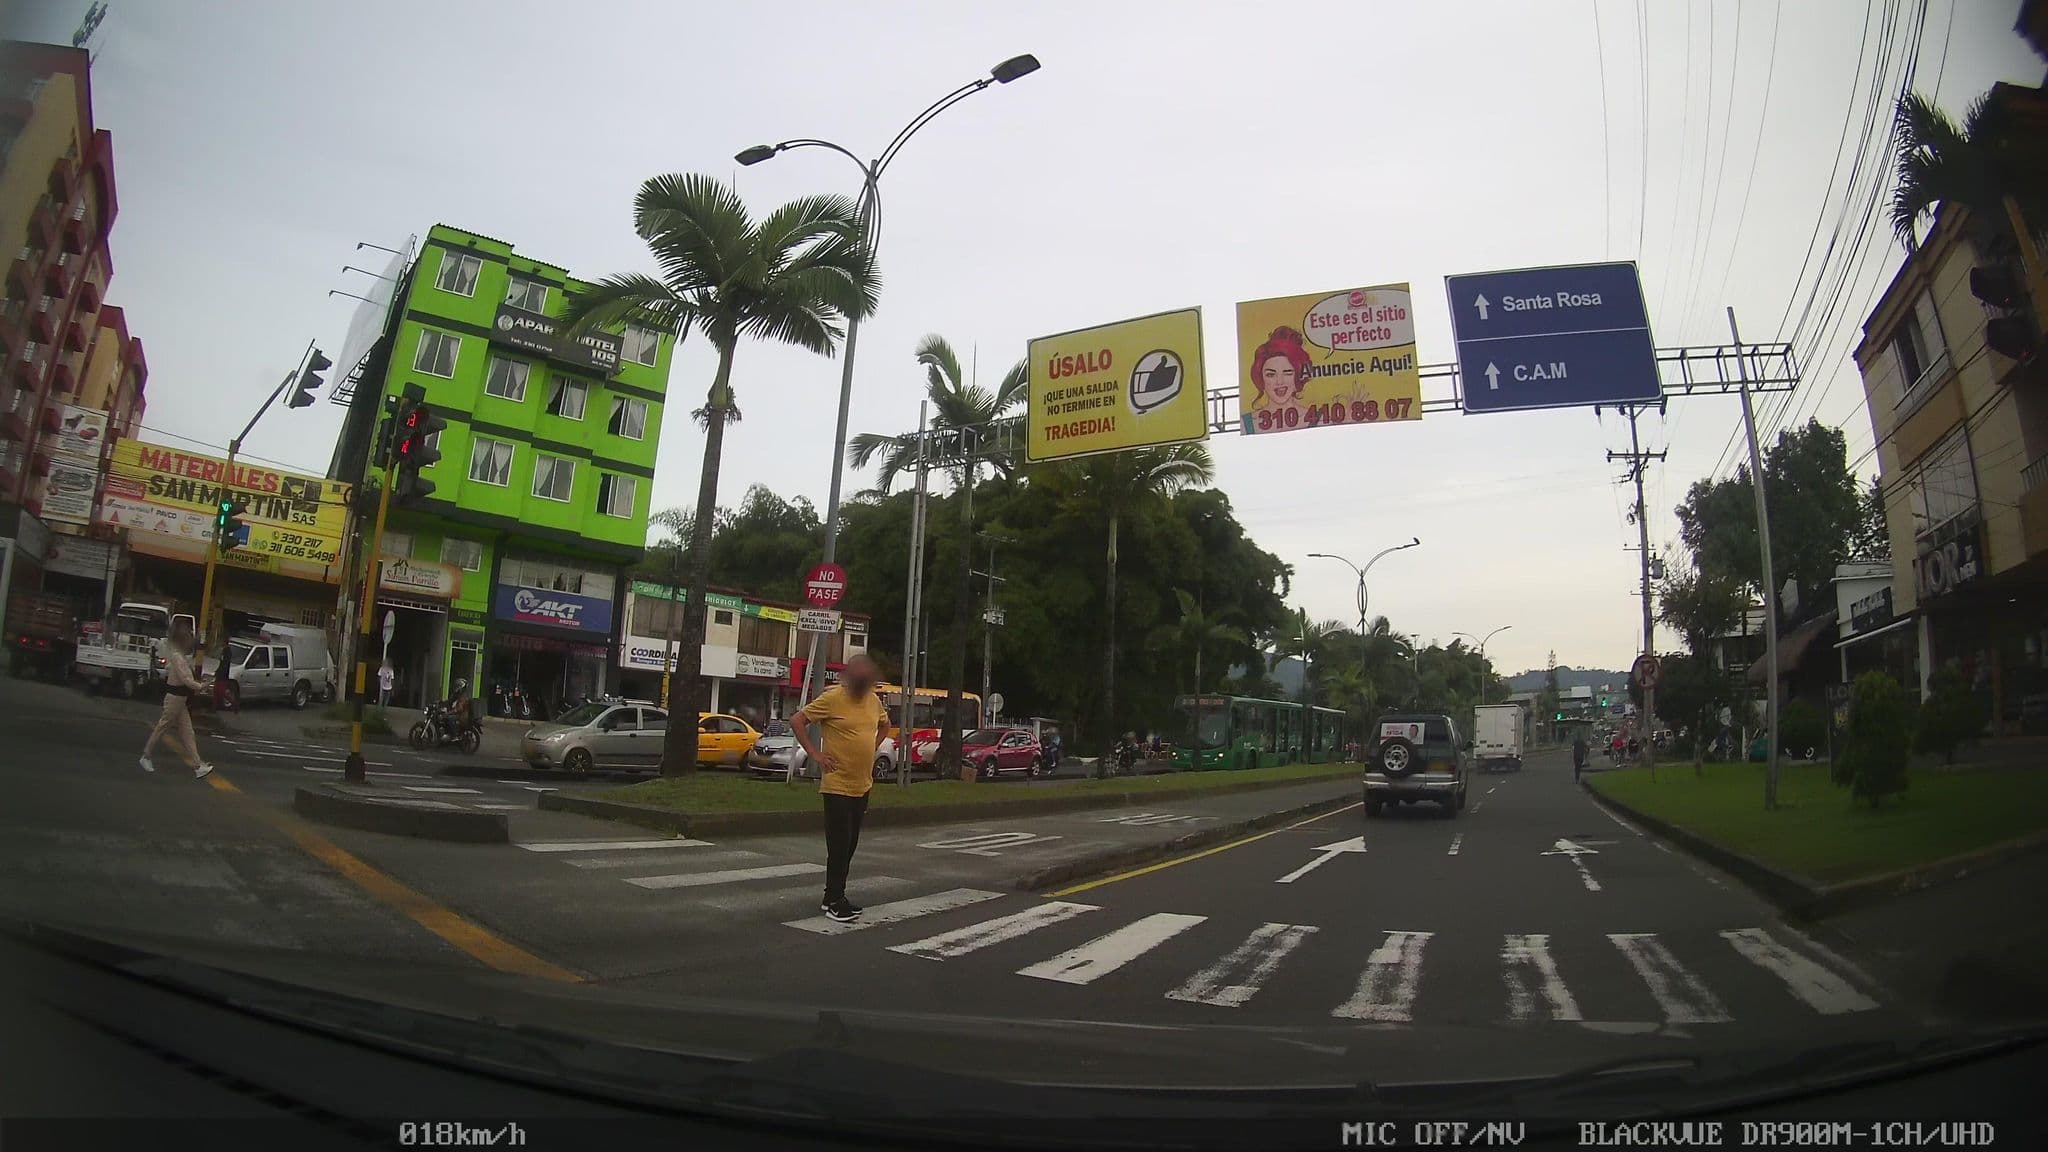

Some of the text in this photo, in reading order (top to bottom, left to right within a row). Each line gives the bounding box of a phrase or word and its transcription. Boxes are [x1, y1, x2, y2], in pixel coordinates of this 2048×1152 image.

[1502, 291, 1603, 312] Santa Rosa
[1310, 304, 1406, 329] Este es el sitio
[1331, 326, 1392, 350] perfecto
[591, 348, 616, 364] 109
[1048, 348, 1112, 379] ÚSALO
[1300, 358, 1365, 379] Anuncie
[1513, 361, 1568, 382] C.A.M
[1066, 385, 1085, 398] UNA
[1086, 380, 1119, 395] SALIDA
[1047, 395, 1116, 416] NO TERMINE EN
[1258, 397, 1413, 430] 310 410 88 07
[1045, 415, 1116, 441] TRAGEDIA!
[140, 446, 279, 492] MATERIALES
[148, 474, 196, 503] SAN
[199, 484, 291, 521] MARTIN
[280, 532, 323, 549] 330 2117
[269, 542, 336, 563] 311 606 5498
[819, 570, 835, 582] NO
[808, 588, 840, 600] PASE
[530, 600, 583, 620] AKT
[800, 617, 836, 625] EXCLSIVO
[801, 623, 832, 631] MEGABUS
[631, 647, 677, 660] COORDIA
